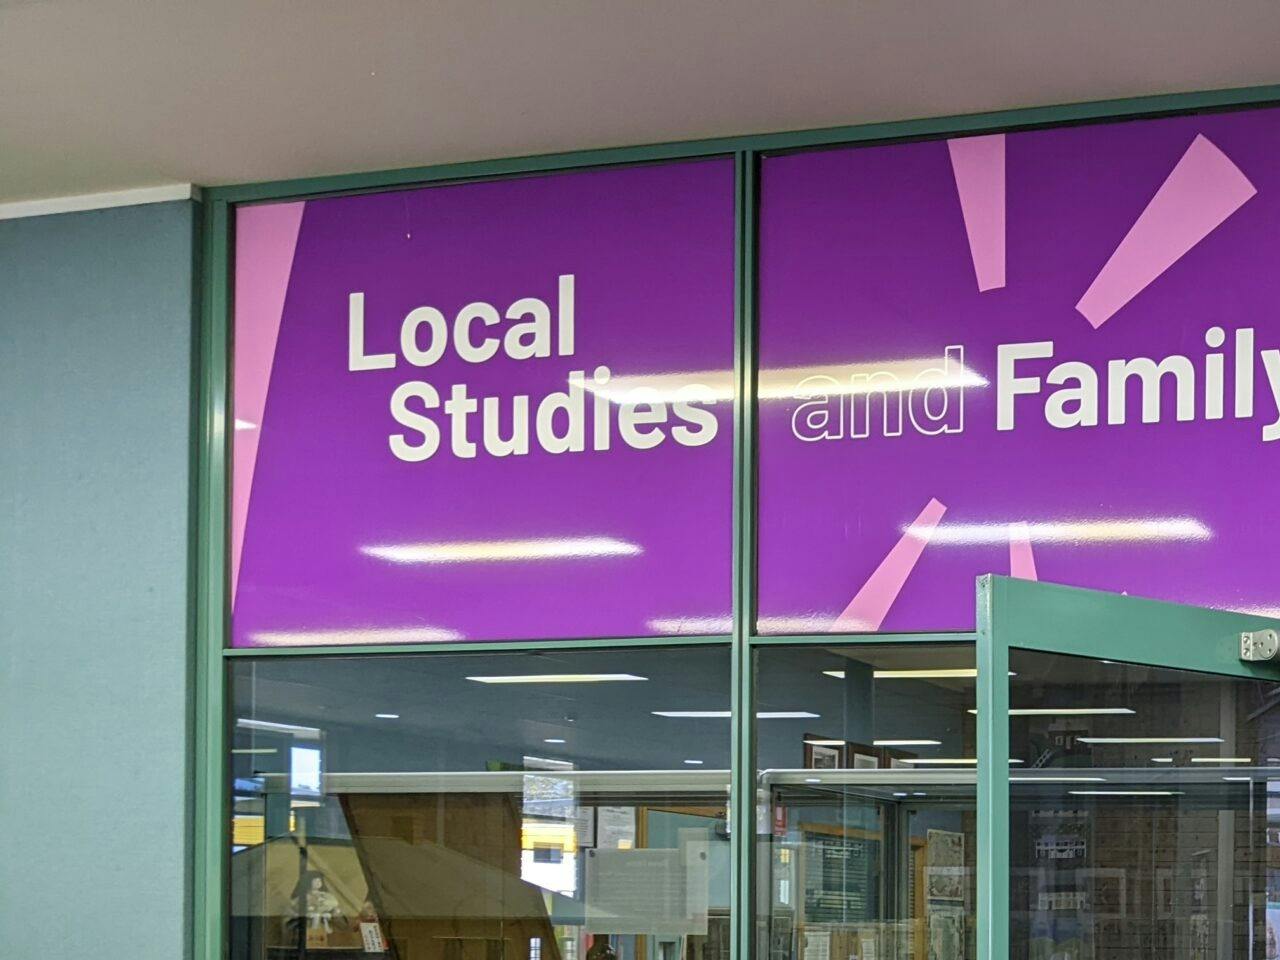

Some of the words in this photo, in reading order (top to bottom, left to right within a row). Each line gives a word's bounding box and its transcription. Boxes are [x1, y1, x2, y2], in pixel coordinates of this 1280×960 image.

[347, 273, 577, 372] Local
[388, 365, 720, 462] Studies
[790, 344, 966, 442] and
